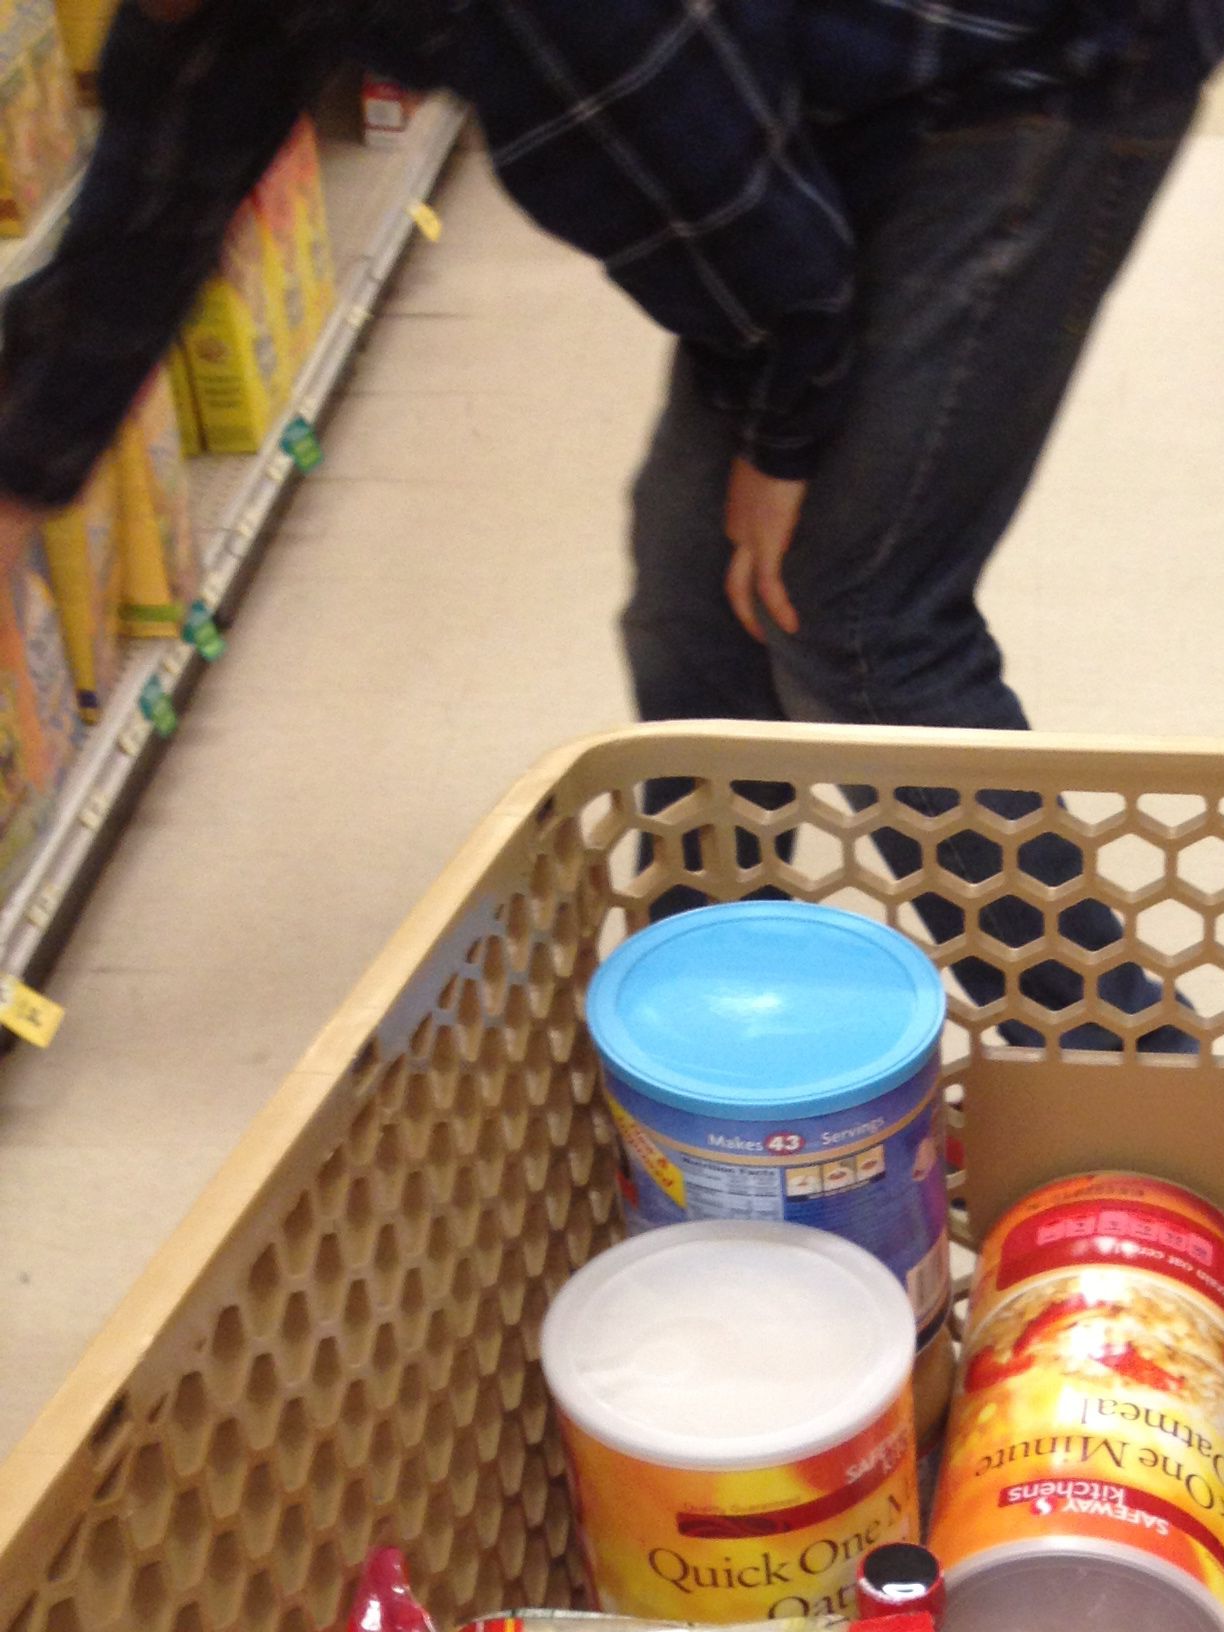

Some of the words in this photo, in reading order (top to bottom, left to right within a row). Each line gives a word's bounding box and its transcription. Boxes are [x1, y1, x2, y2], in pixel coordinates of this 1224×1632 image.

[708, 1134, 764, 1152] Makes
[767, 1133, 802, 1150] 43
[822, 1115, 885, 1145] Servings
[975, 1434, 1130, 1477] Minute
[1007, 1480, 1128, 1506] kitchens
[1138, 1445, 1215, 1510] One
[1061, 1497, 1171, 1536] SAFEWAY
[648, 1547, 792, 1594] Quick
[799, 1518, 881, 1575] One
